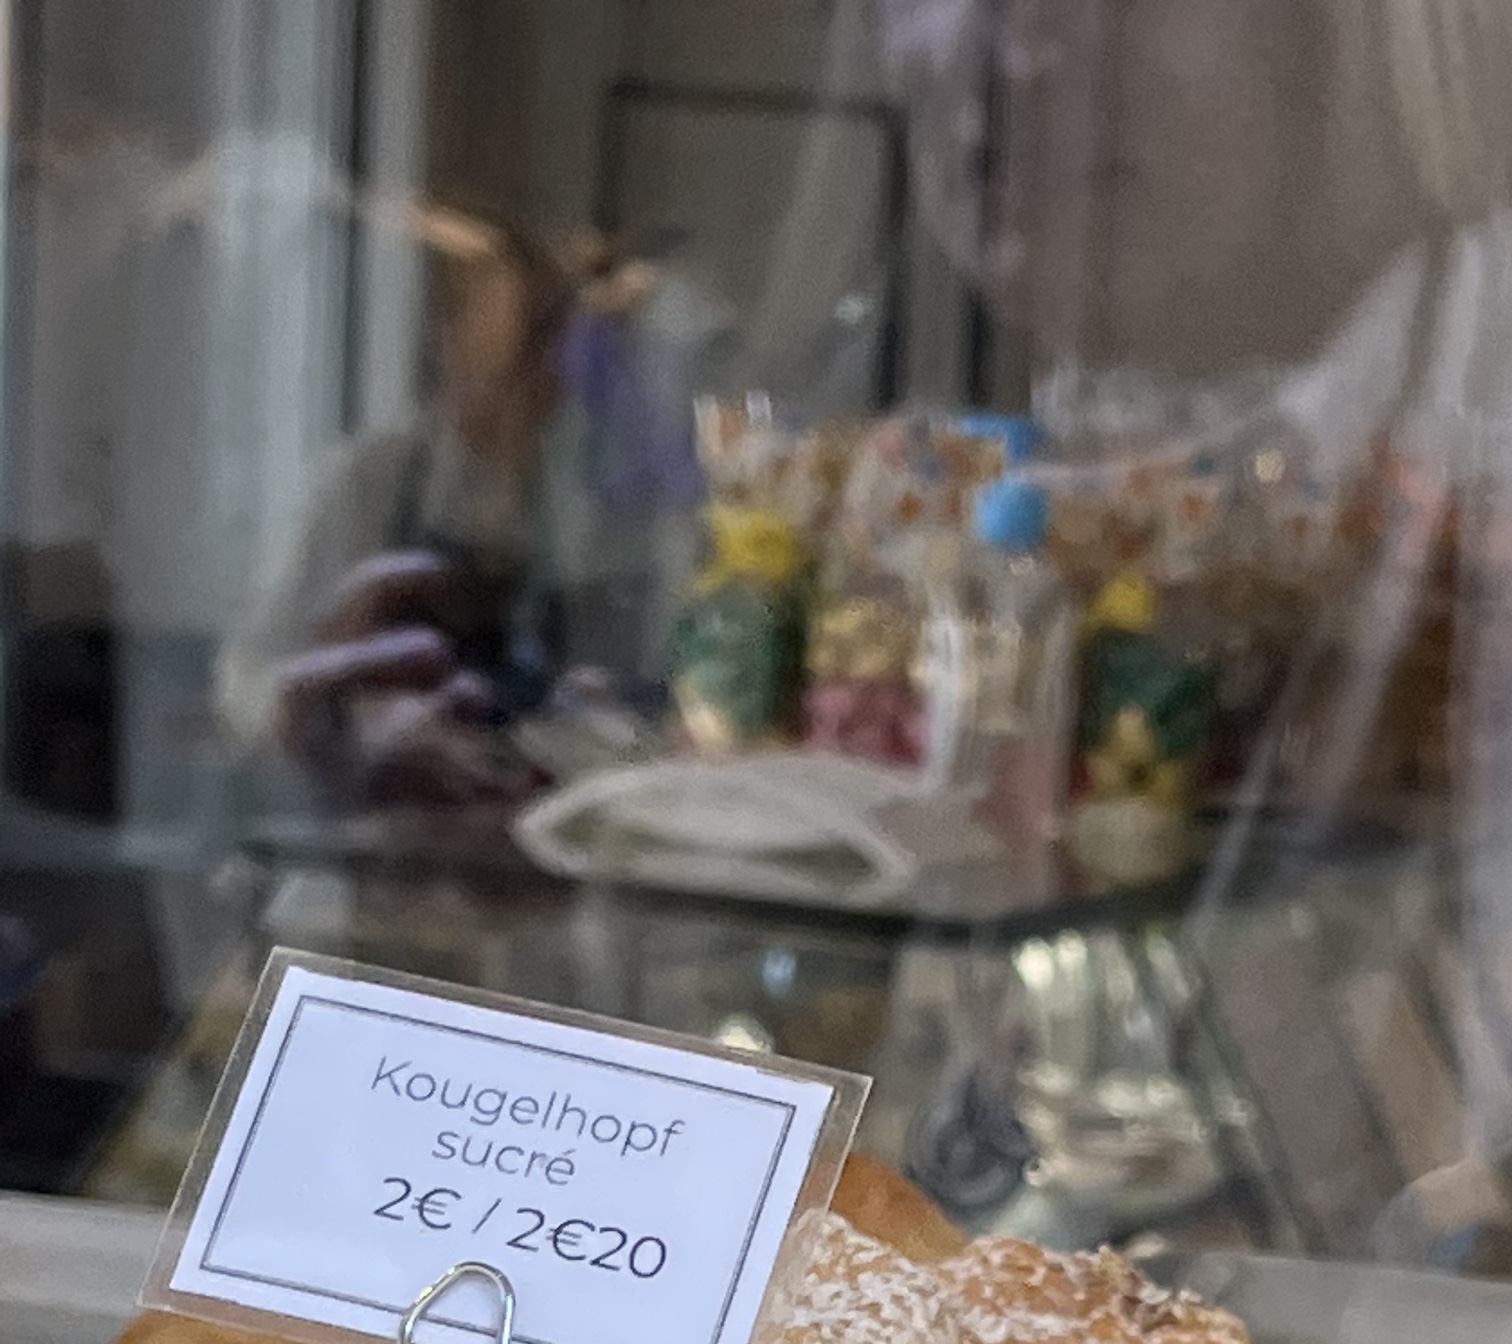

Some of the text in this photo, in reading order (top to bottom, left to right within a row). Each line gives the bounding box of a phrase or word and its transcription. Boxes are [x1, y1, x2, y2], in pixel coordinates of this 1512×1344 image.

[370, 1055, 686, 1157] Kougelhopf
[430, 1130, 577, 1186] sucré
[504, 1206, 668, 1279] 2€20
